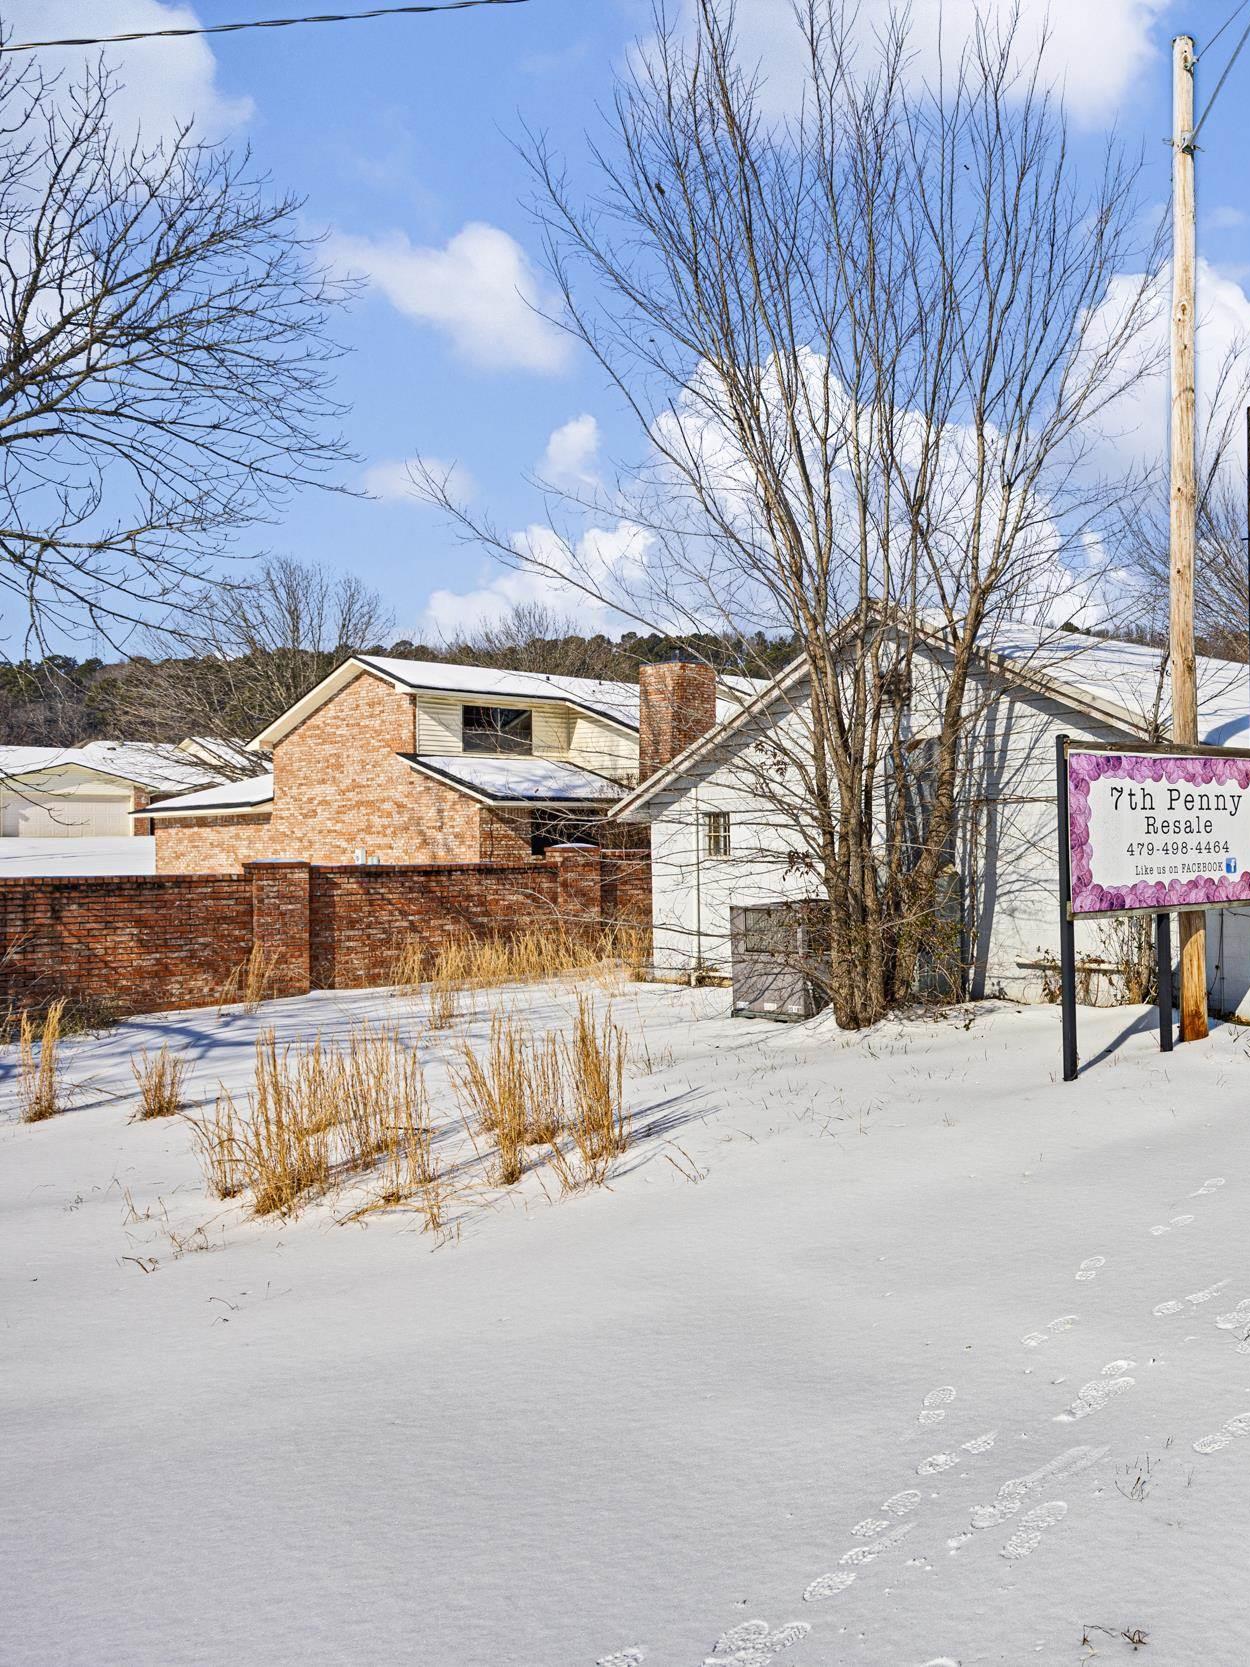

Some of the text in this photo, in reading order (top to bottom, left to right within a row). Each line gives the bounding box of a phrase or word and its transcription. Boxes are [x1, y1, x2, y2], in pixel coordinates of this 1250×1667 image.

[1110, 787, 1243, 816] 7th Penny
[1145, 816, 1213, 834] Resale
[1127, 841, 1230, 856] 479-498-4464
[1135, 865, 1153, 876] Like
[1157, 866, 1166, 874] us
[1169, 866, 1179, 874] on
[1181, 862, 1223, 873] FACEBOOK
